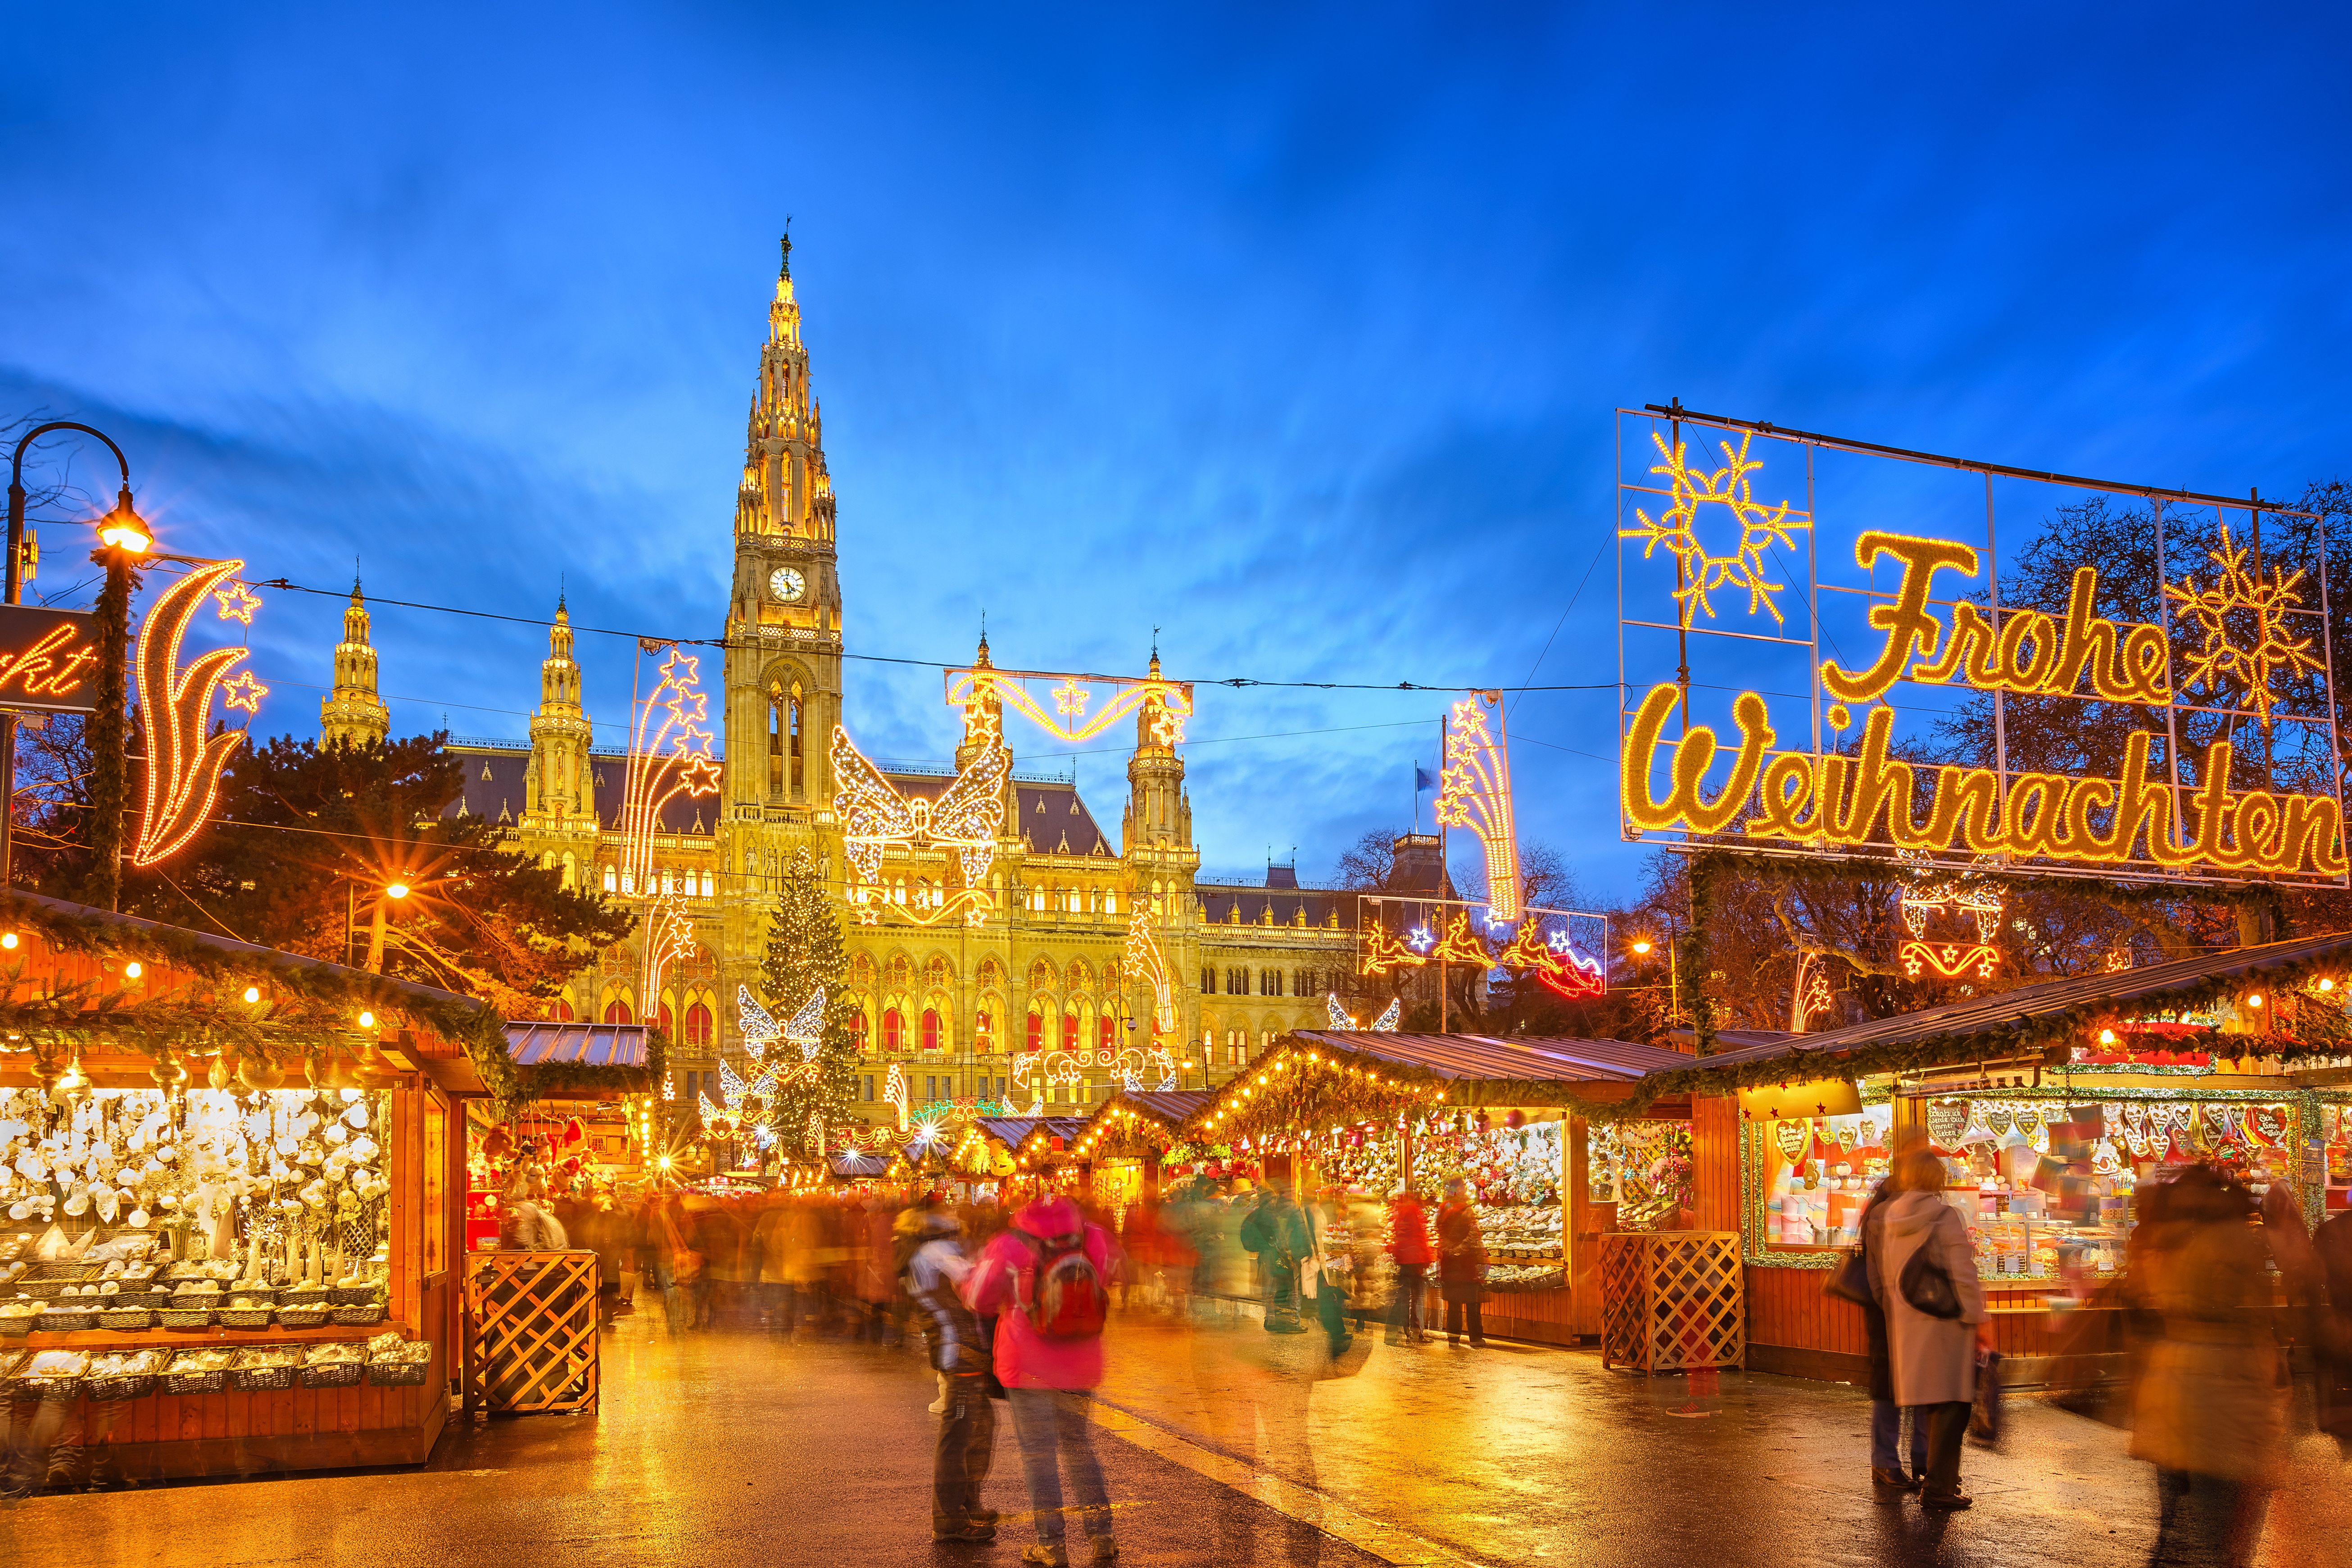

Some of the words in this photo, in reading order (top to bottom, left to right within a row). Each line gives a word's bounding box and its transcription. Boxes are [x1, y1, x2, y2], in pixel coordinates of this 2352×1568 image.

[1820, 530, 2173, 705] Frohe
[1623, 683, 2348, 875] Weihnachten
[2259, 1114, 2275, 1122] Ich
